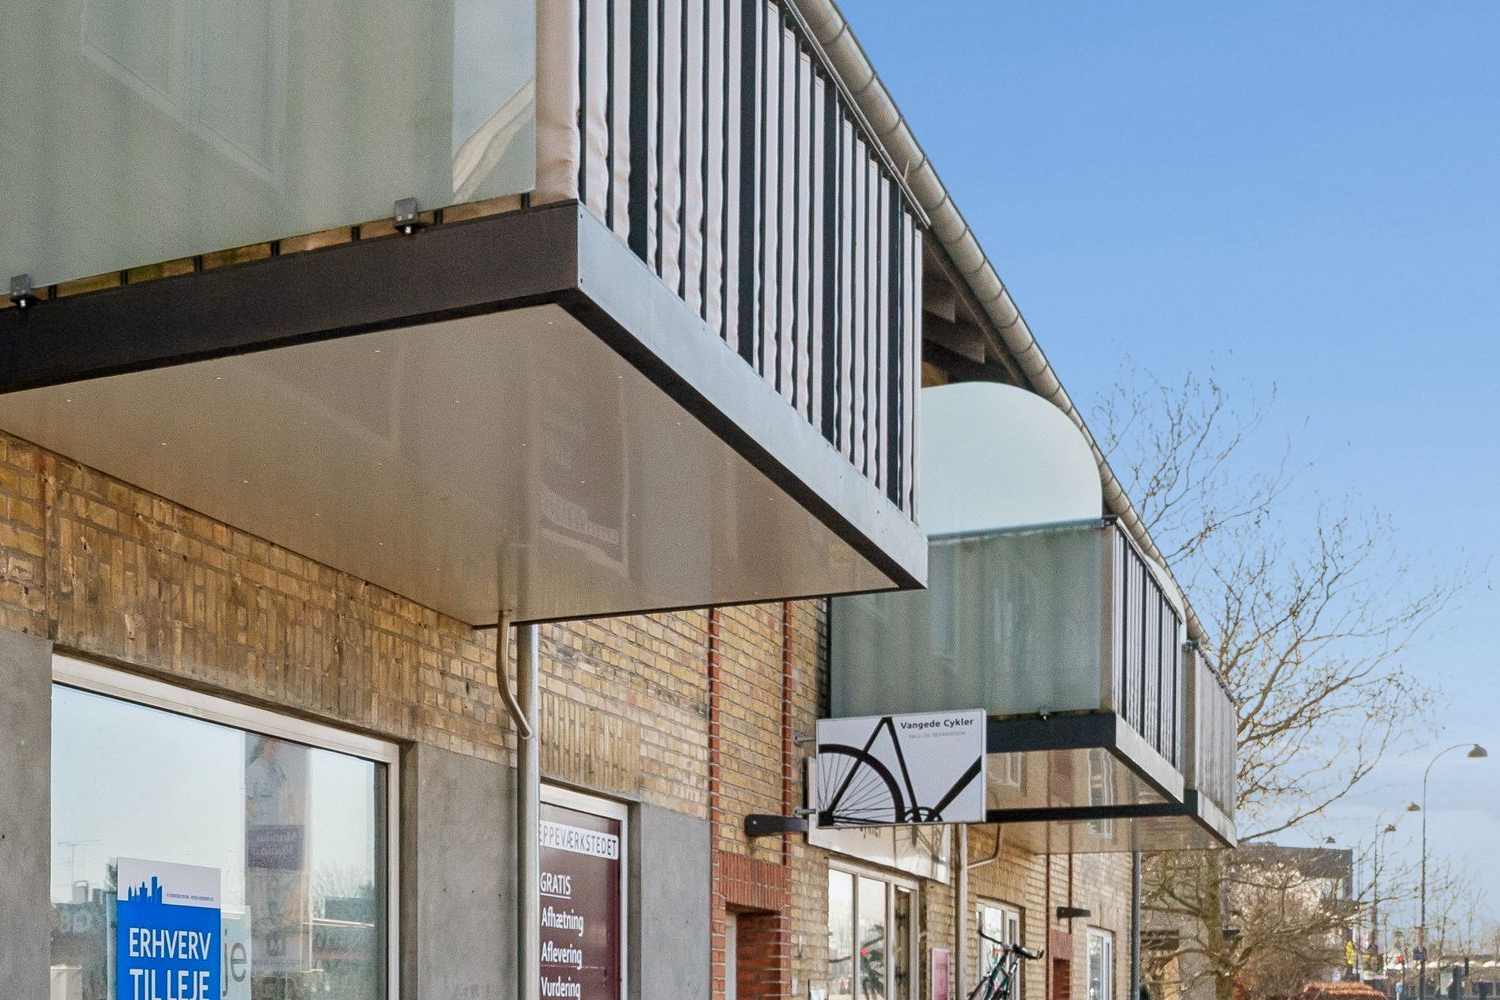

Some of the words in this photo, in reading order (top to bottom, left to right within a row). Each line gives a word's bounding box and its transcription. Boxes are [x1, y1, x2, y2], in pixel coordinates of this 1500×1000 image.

[900, 720, 941, 730] Vangede
[943, 718, 974, 728] Cykler
[540, 872, 572, 896] GRATIS
[541, 906, 584, 937] Afhætning
[129, 927, 211, 960] ERHVERV
[541, 940, 582, 970] Aflevering
